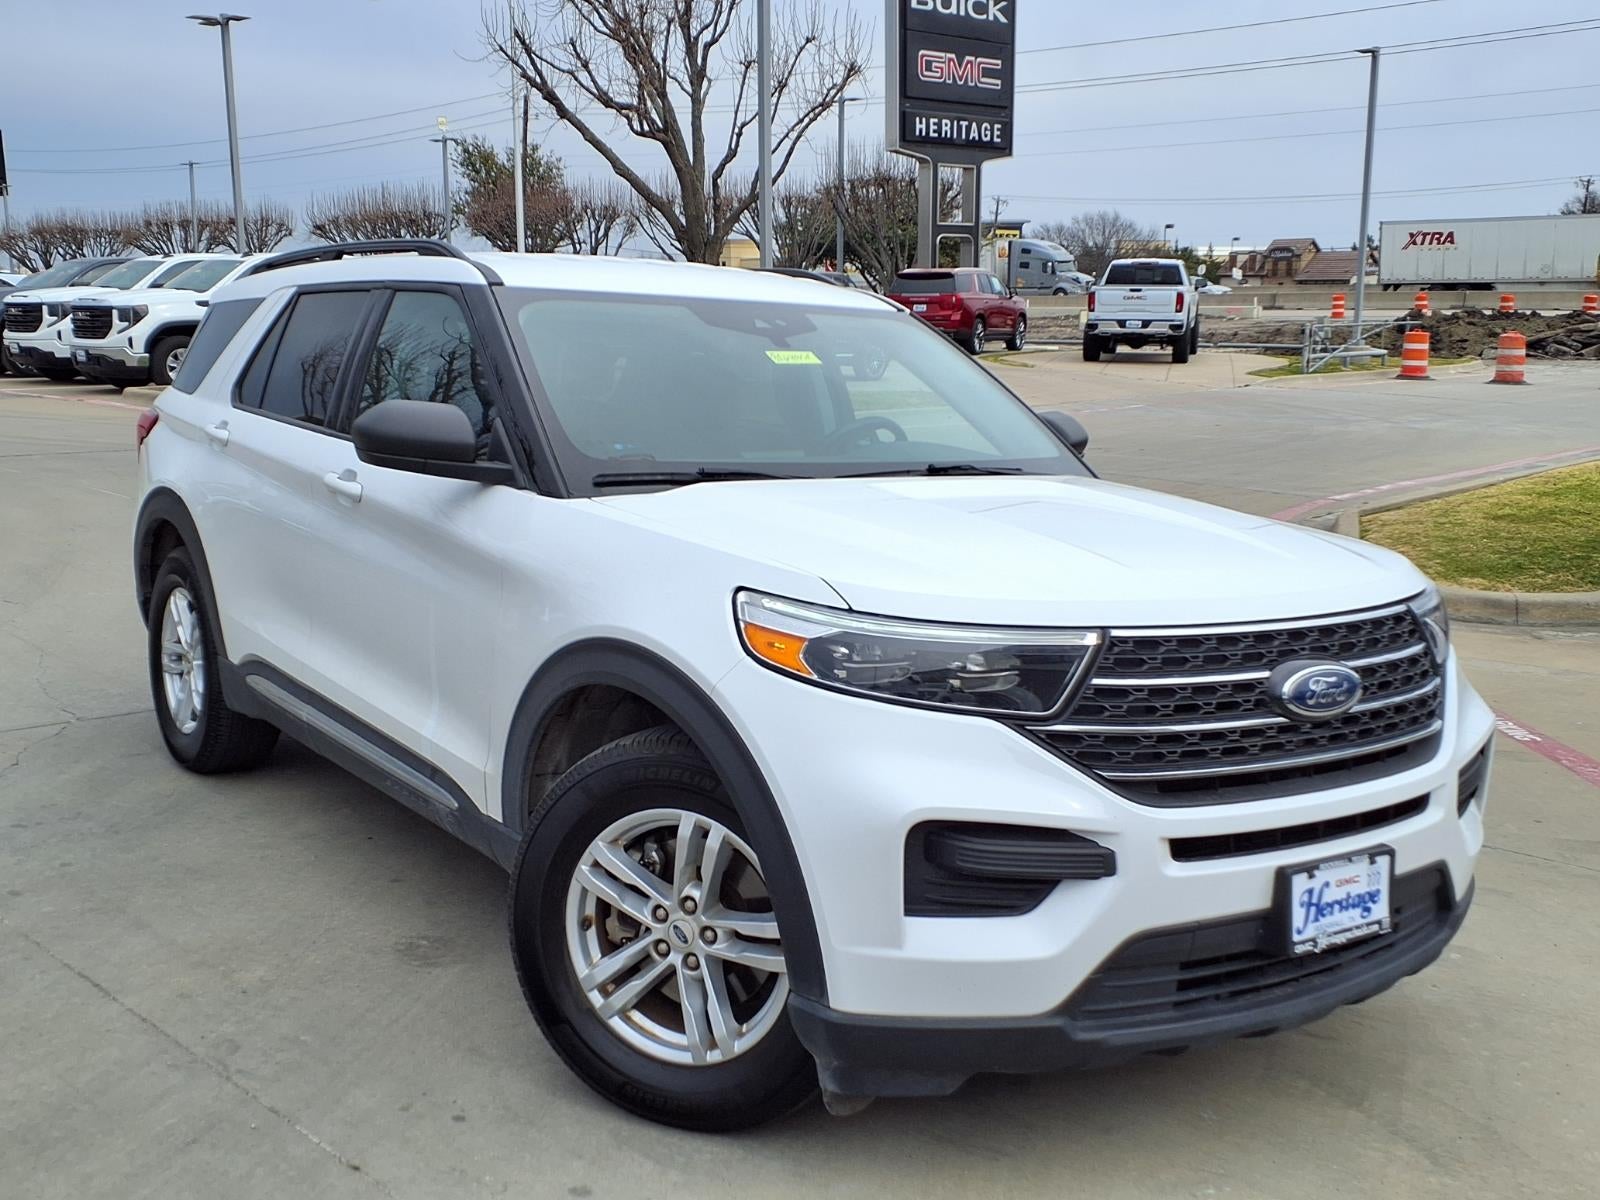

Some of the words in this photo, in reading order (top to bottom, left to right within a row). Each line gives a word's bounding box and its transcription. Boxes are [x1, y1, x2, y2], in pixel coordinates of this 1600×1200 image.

[918, 50, 1002, 90] GMC
[915, 116, 1002, 142] HERITAGE
[1401, 230, 1455, 250] XTRA
[1306, 676, 1348, 705] Ford
[1335, 875, 1360, 887] GMC
[1296, 881, 1381, 935] Heritage
